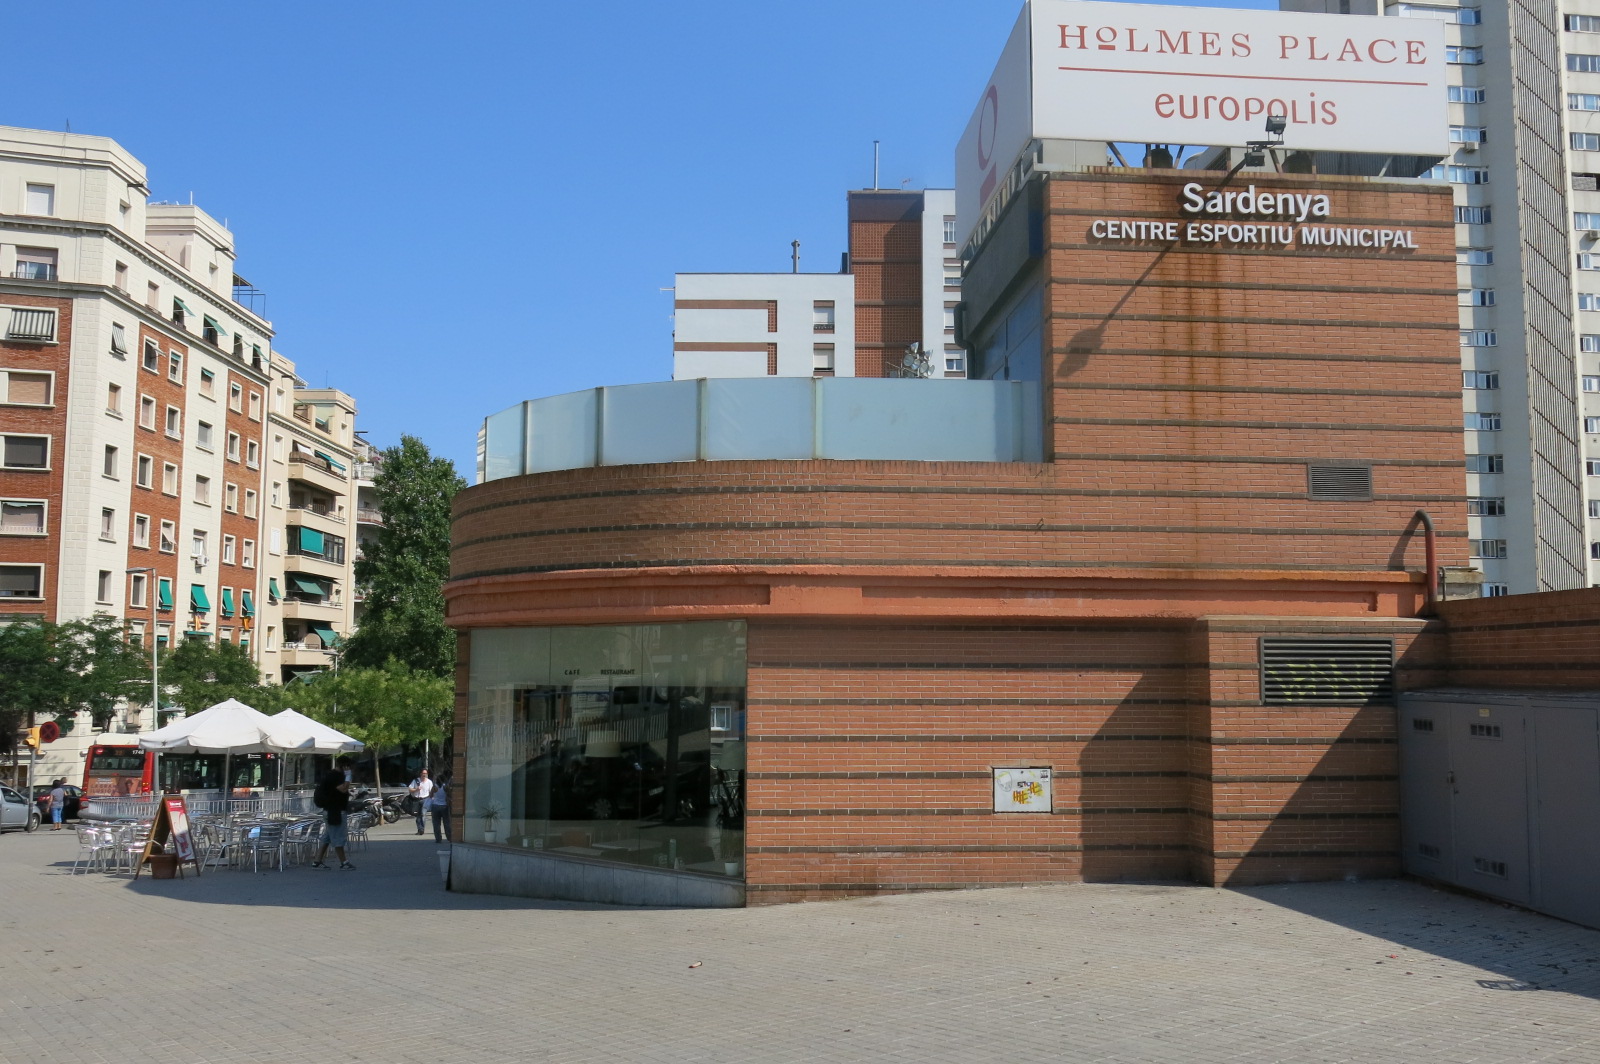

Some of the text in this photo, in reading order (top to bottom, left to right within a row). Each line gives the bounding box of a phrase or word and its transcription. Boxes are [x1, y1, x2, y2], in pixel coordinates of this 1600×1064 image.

[1057, 24, 1428, 65] HOLMES PLACE
[1154, 91, 1338, 126] europolis
[1182, 182, 1331, 223] Sardenya
[1091, 219, 1420, 249] CENTRE ESPORTIU MUNICIPAL
